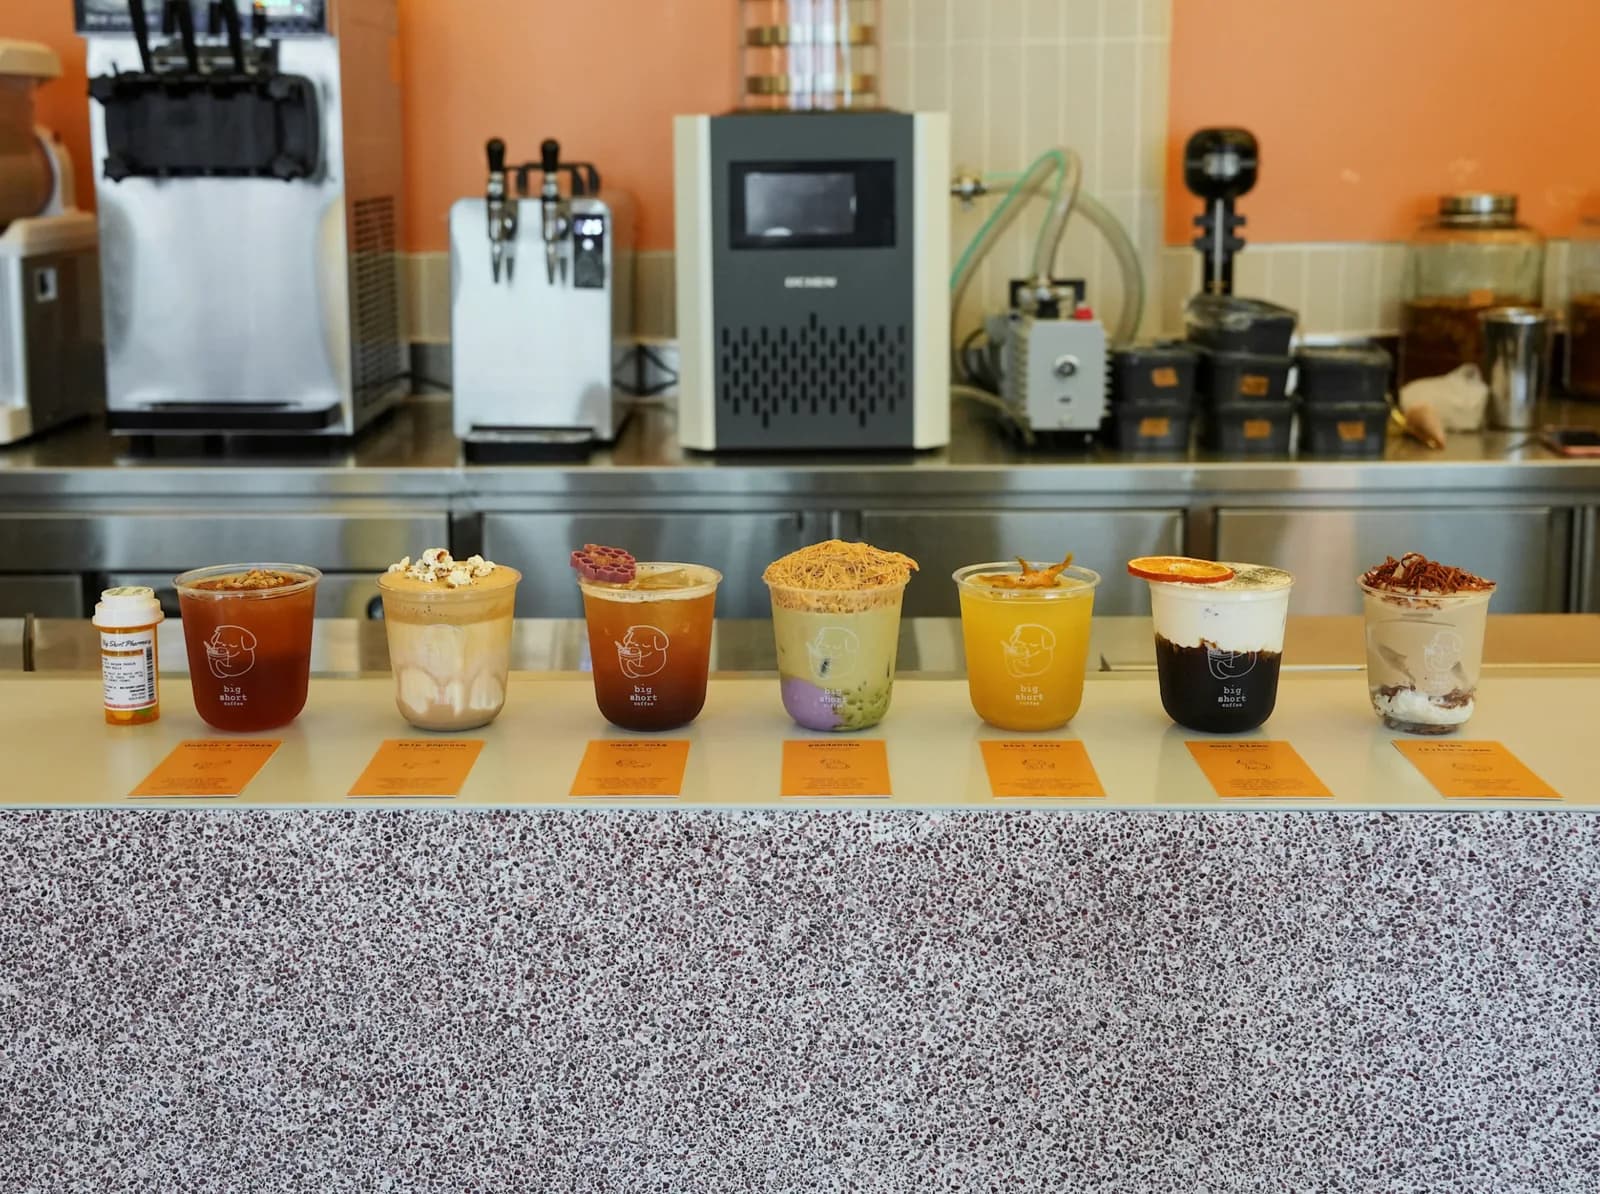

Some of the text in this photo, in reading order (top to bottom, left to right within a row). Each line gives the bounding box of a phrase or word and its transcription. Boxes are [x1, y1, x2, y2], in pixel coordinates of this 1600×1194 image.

[224, 683, 241, 694] big
[633, 683, 652, 694] big
[1223, 684, 1242, 695] big
